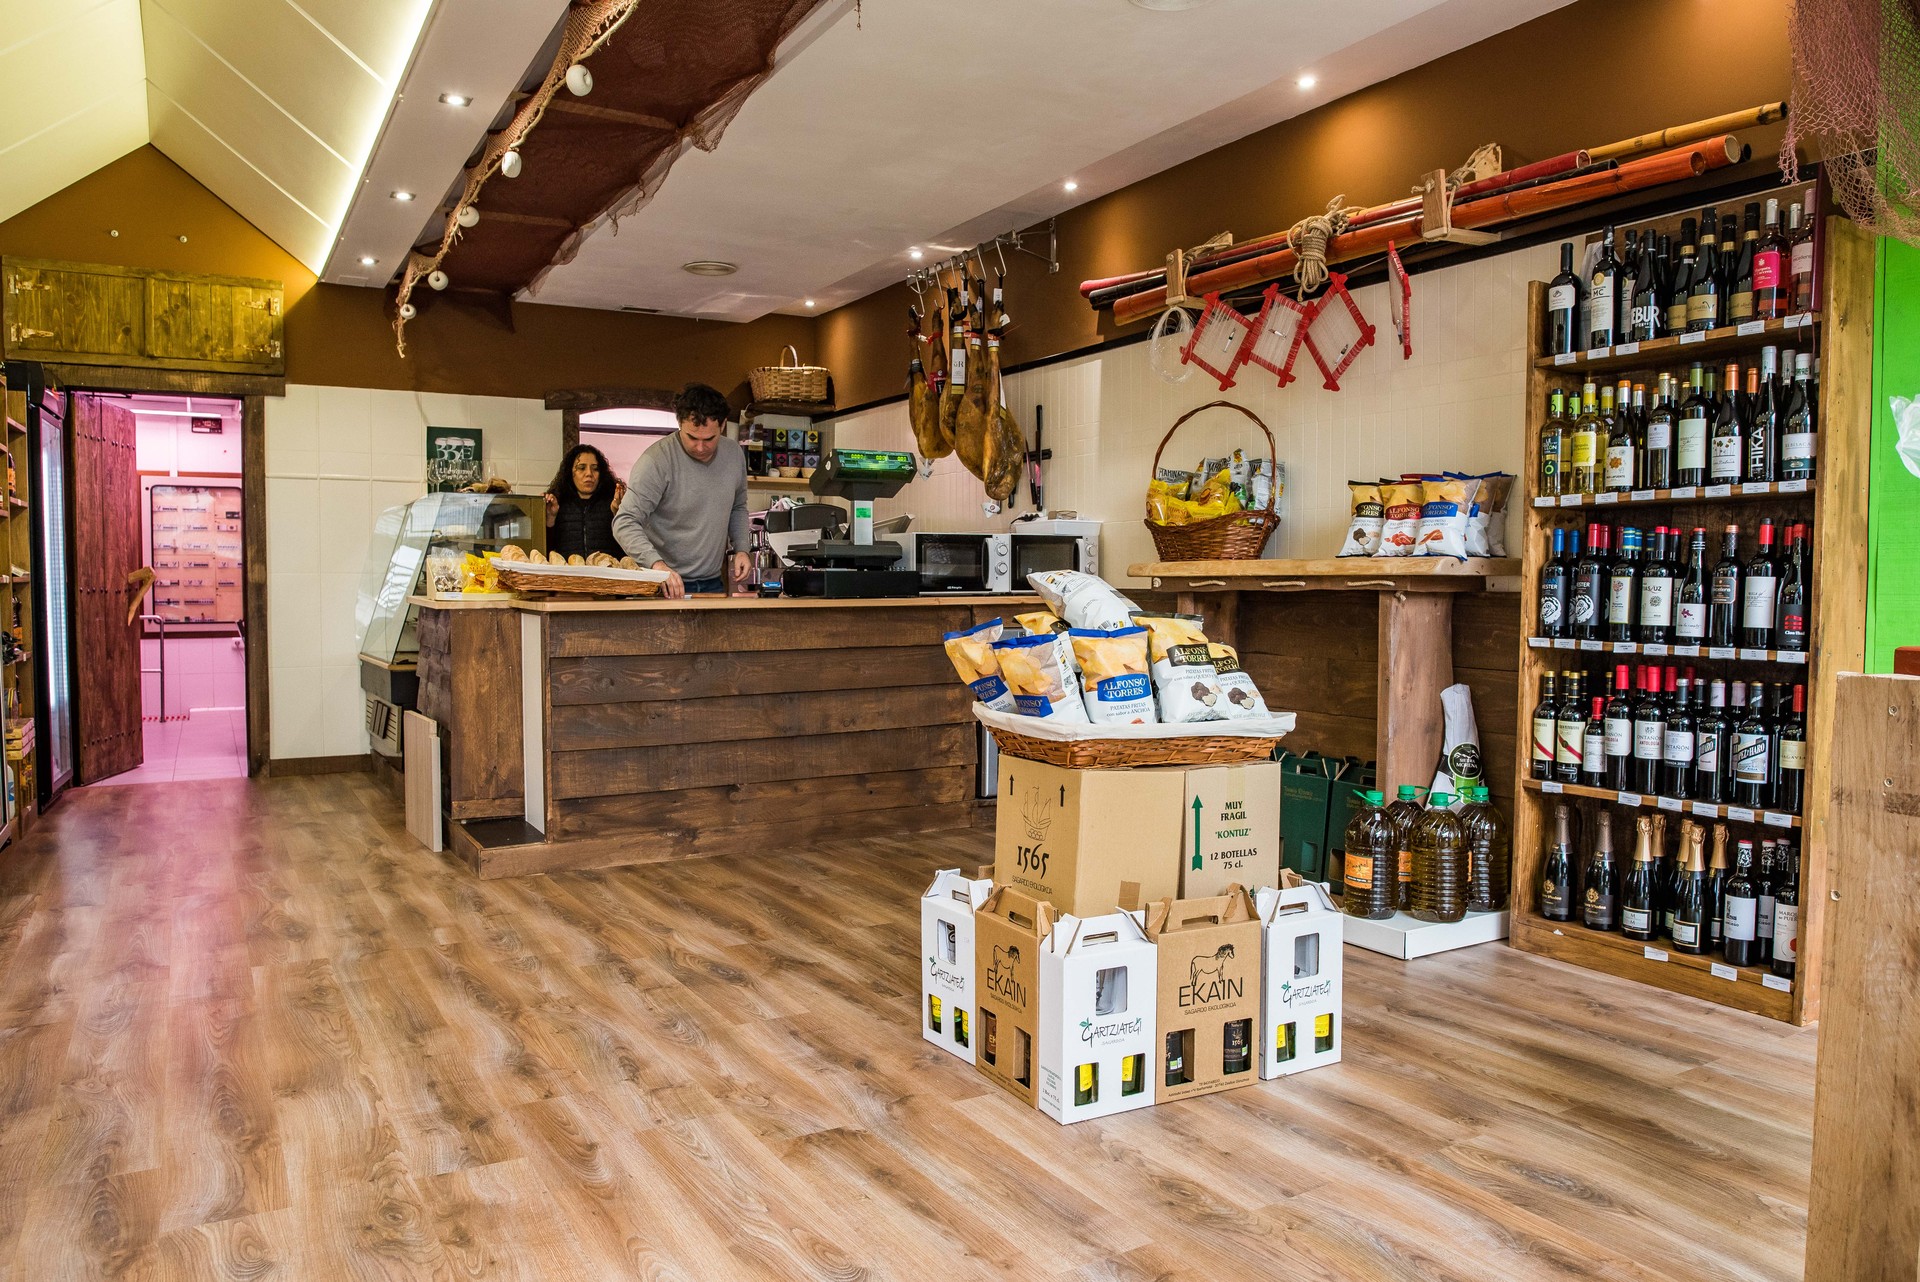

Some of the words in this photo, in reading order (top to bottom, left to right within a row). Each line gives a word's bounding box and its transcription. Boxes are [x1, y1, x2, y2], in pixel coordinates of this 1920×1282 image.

[1103, 677, 1145, 691] ALFONSO
[1106, 687, 1144, 699] TORRES
[1110, 703, 1131, 711] PATATAS
[1225, 801, 1243, 810] MUY
[1221, 811, 1247, 821] FRAGIL
[1215, 828, 1252, 839] "KONTUZ"
[1211, 852, 1218, 860] 12
[1221, 848, 1258, 860] BOTELLAS
[1017, 844, 1050, 880] 1565
[1235, 860, 1244, 868] cl.
[987, 968, 1027, 1008] EKAIN
[1179, 977, 1243, 1007] EKAIN
[1184, 1006, 1207, 1016] SAGARDO
[1208, 1002, 1237, 1012] EKOLOGIKOA
[1082, 1019, 1142, 1048] GARTZIATEGI
